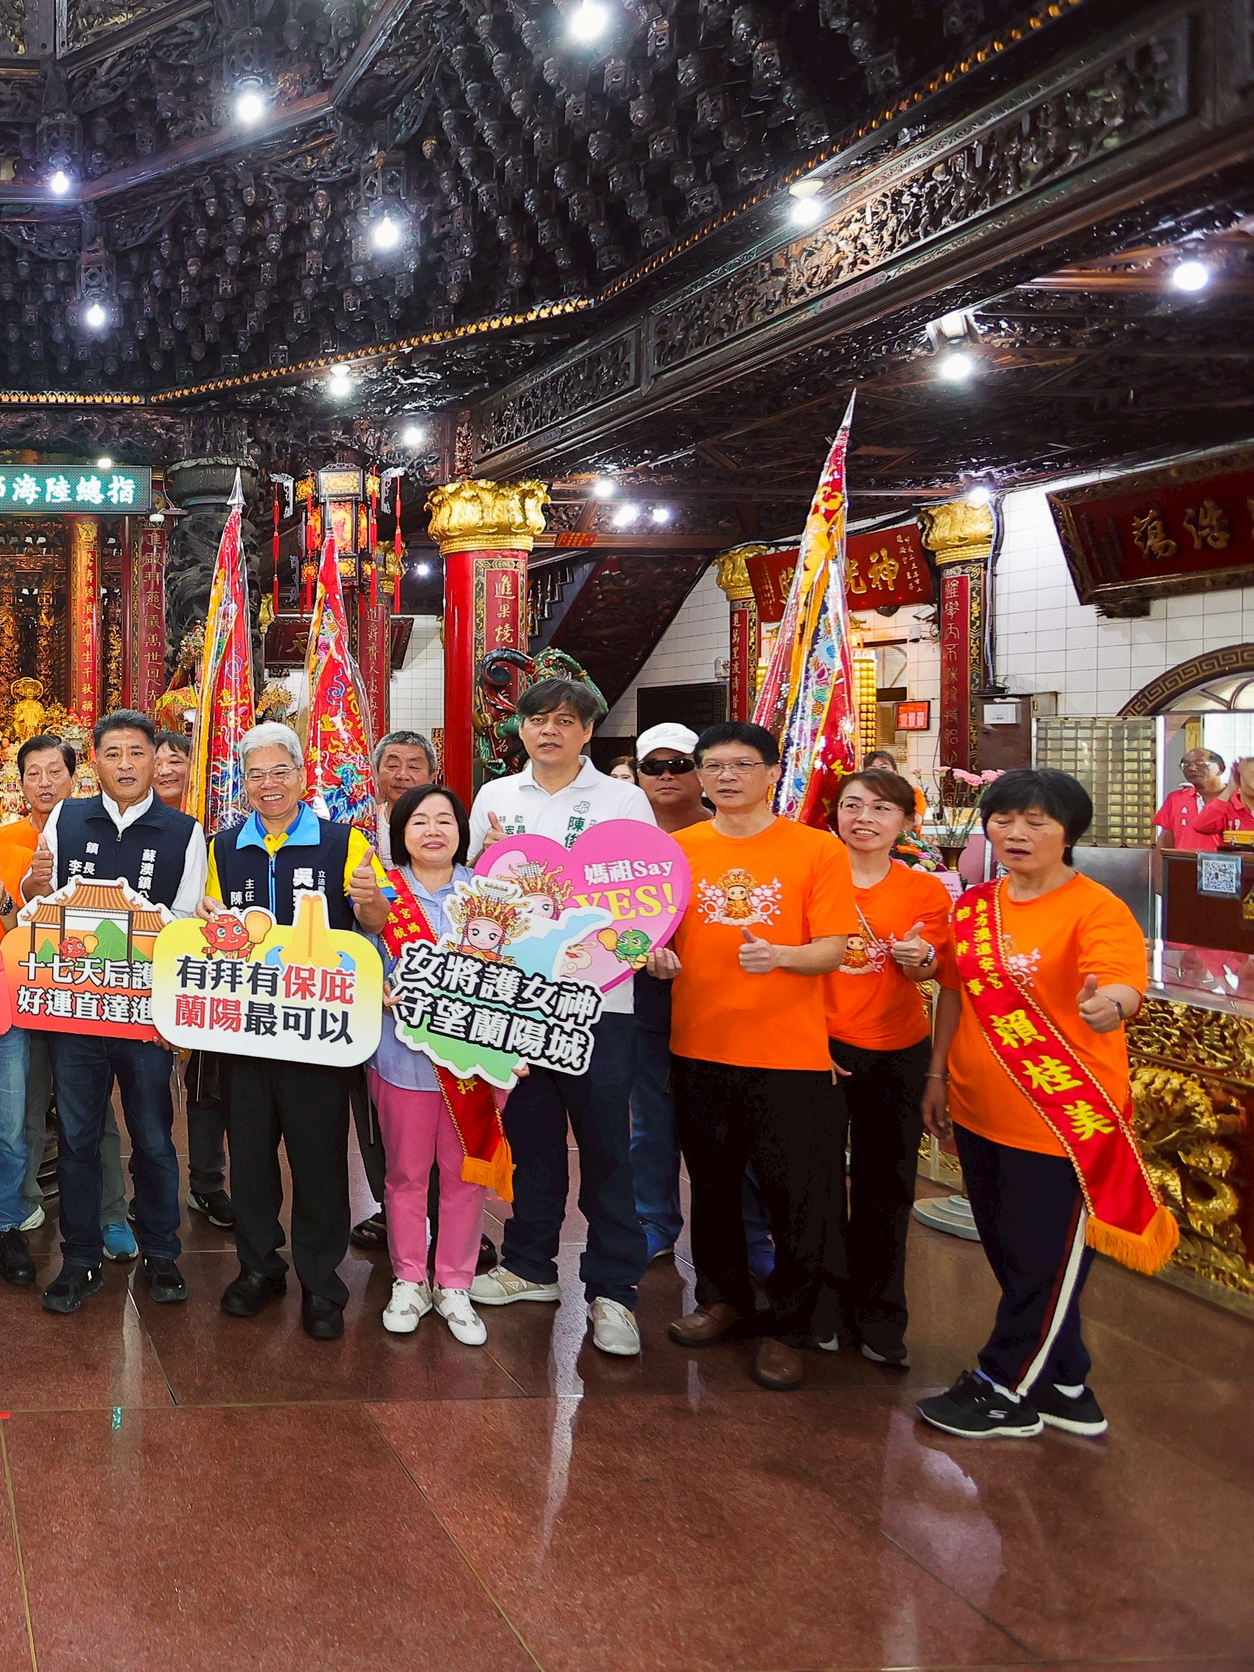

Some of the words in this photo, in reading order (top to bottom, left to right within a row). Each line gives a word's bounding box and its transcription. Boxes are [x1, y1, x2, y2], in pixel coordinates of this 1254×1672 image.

[1132, 497, 1254, 560] 浩蕩
[244, 878, 255, 903] 主任
[583, 860, 674, 887] 媽祖Say
[176, 955, 355, 1005] 有拜有保庇
[401, 943, 602, 1026] 女將護女神
[175, 994, 354, 1045] 蘭陽最可以
[397, 985, 592, 1072] 守望蘭陽城
[989, 1009, 1116, 1142] 賴桂美
